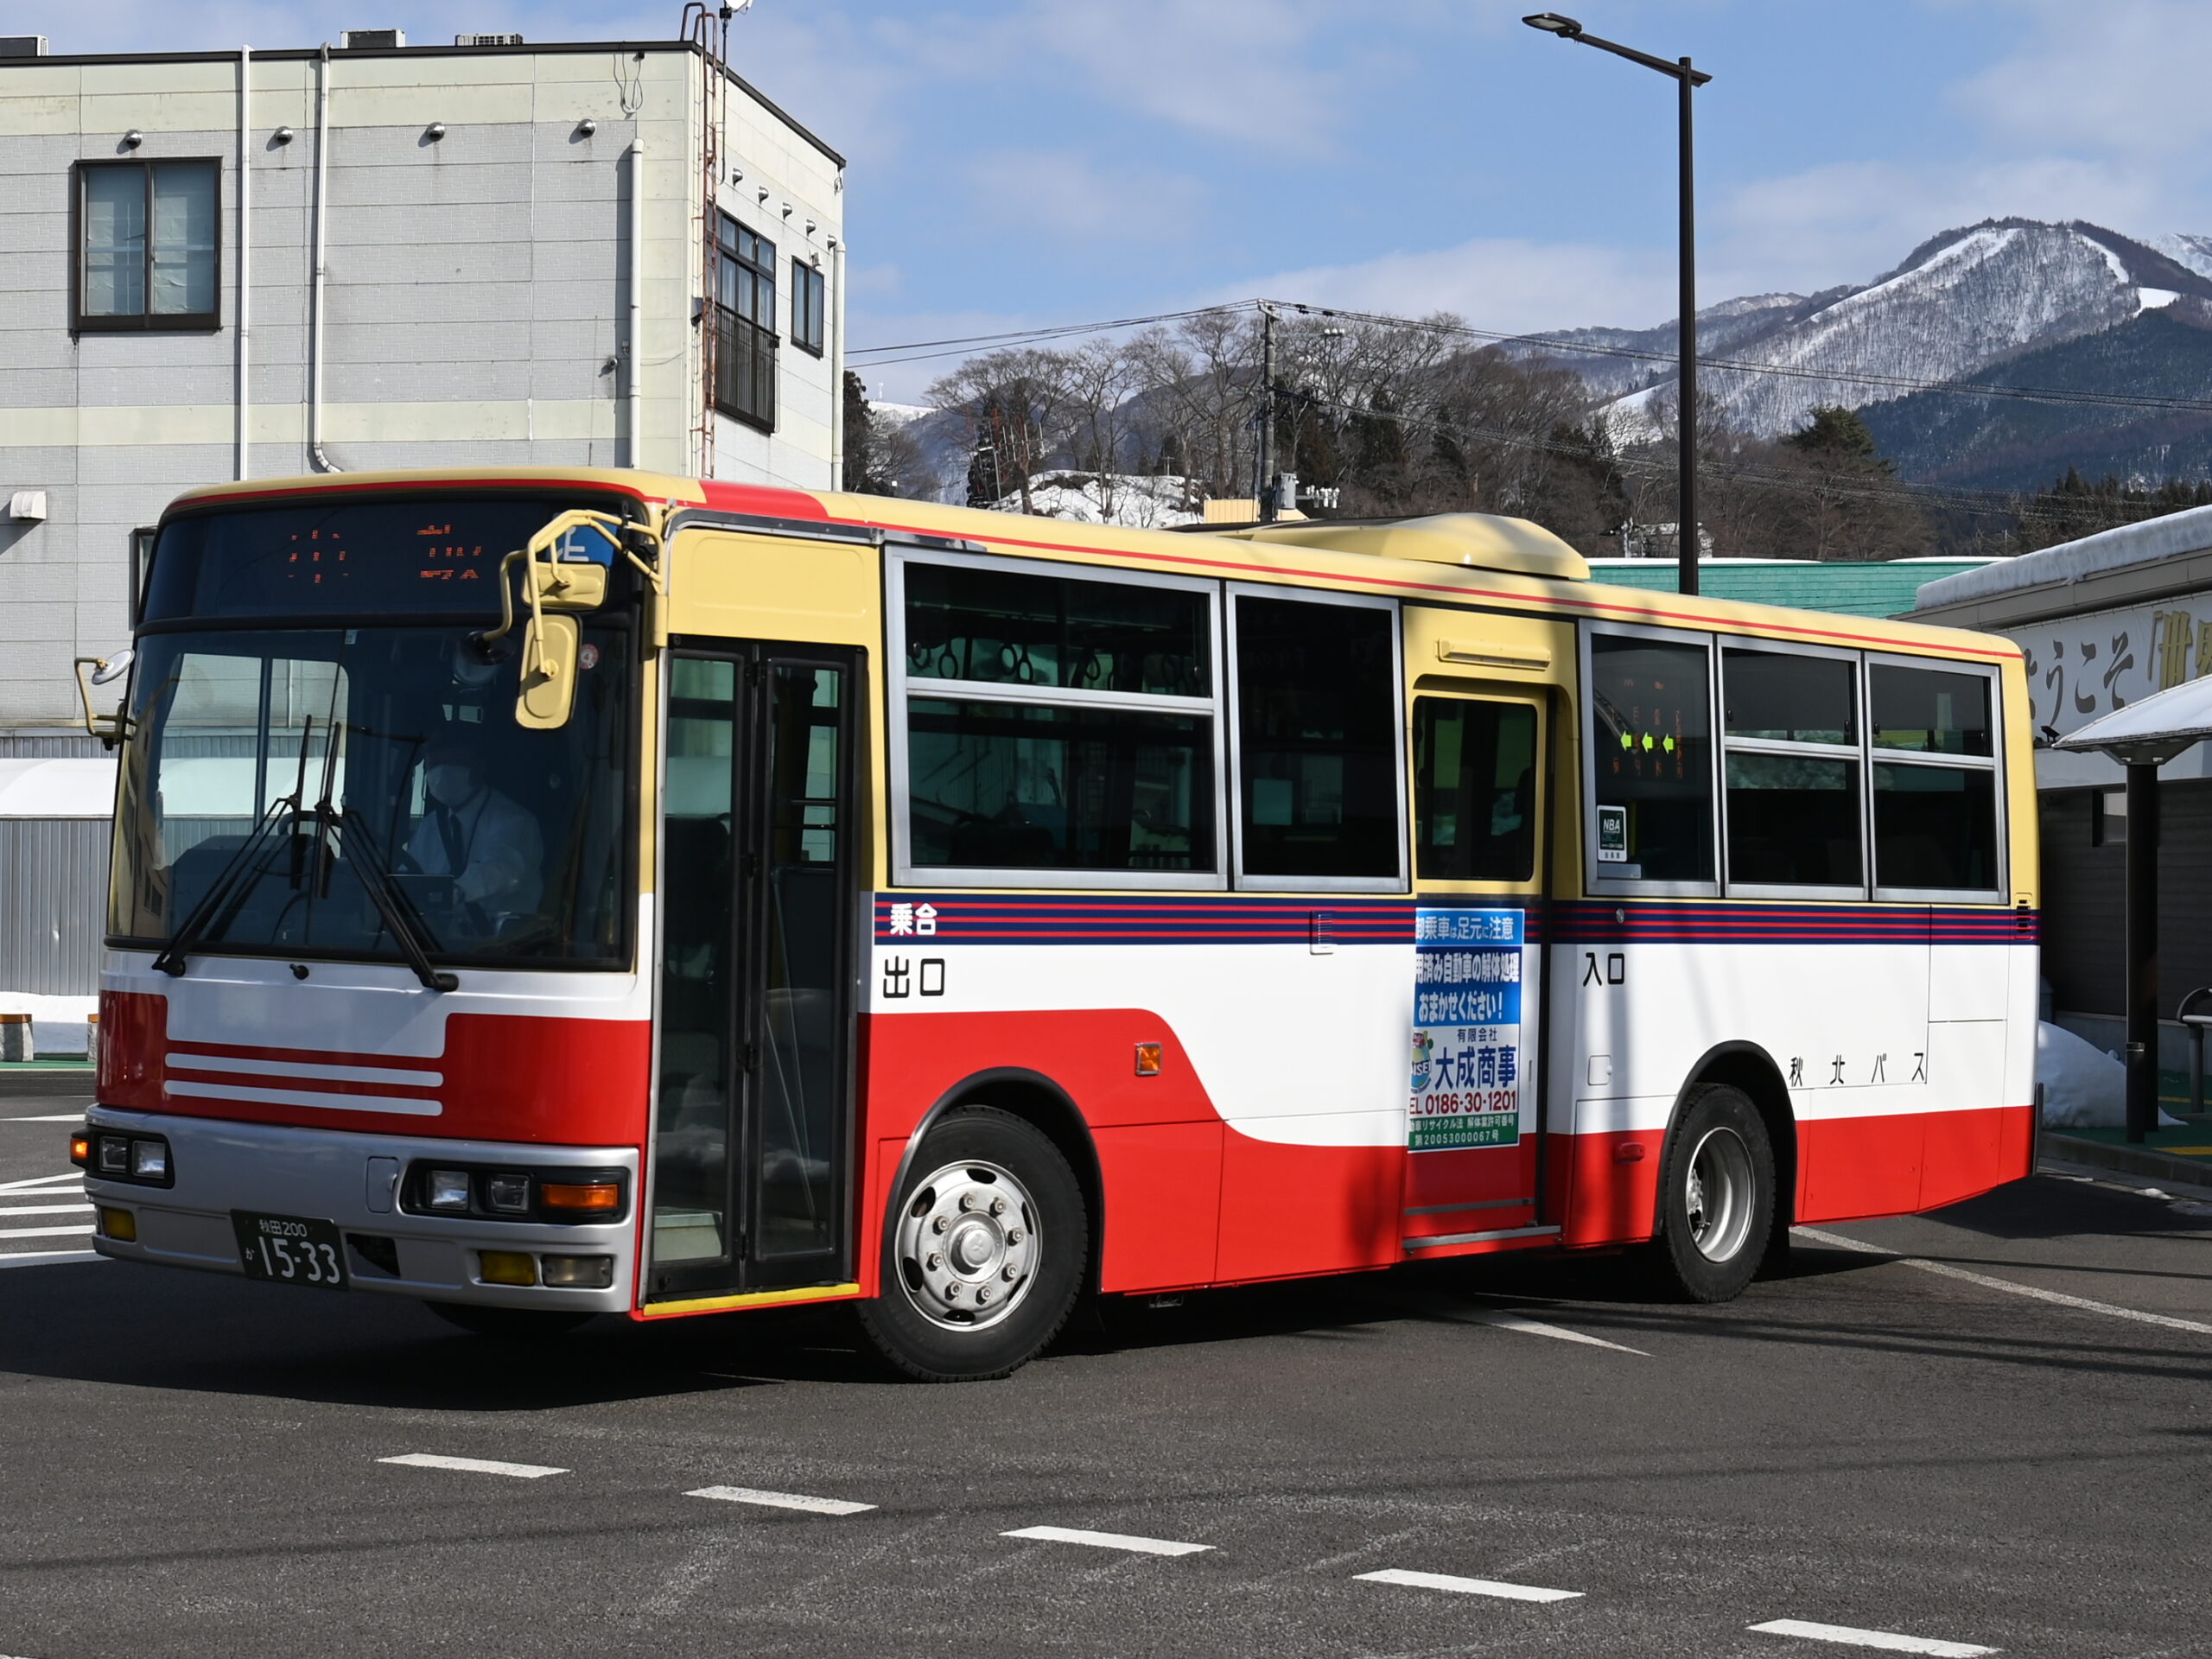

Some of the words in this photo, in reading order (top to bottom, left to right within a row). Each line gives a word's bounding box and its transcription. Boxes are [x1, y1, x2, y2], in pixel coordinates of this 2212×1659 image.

[1603, 818, 1621, 831] NBA
[890, 902, 938, 936] 乗合
[883, 956, 944, 998] 出口
[1583, 952, 1624, 987] 入口
[1457, 1027, 1497, 1043] 有限会社
[1435, 1045, 1516, 1090] 大成商事
[1789, 1052, 1924, 1087] 秋北バス
